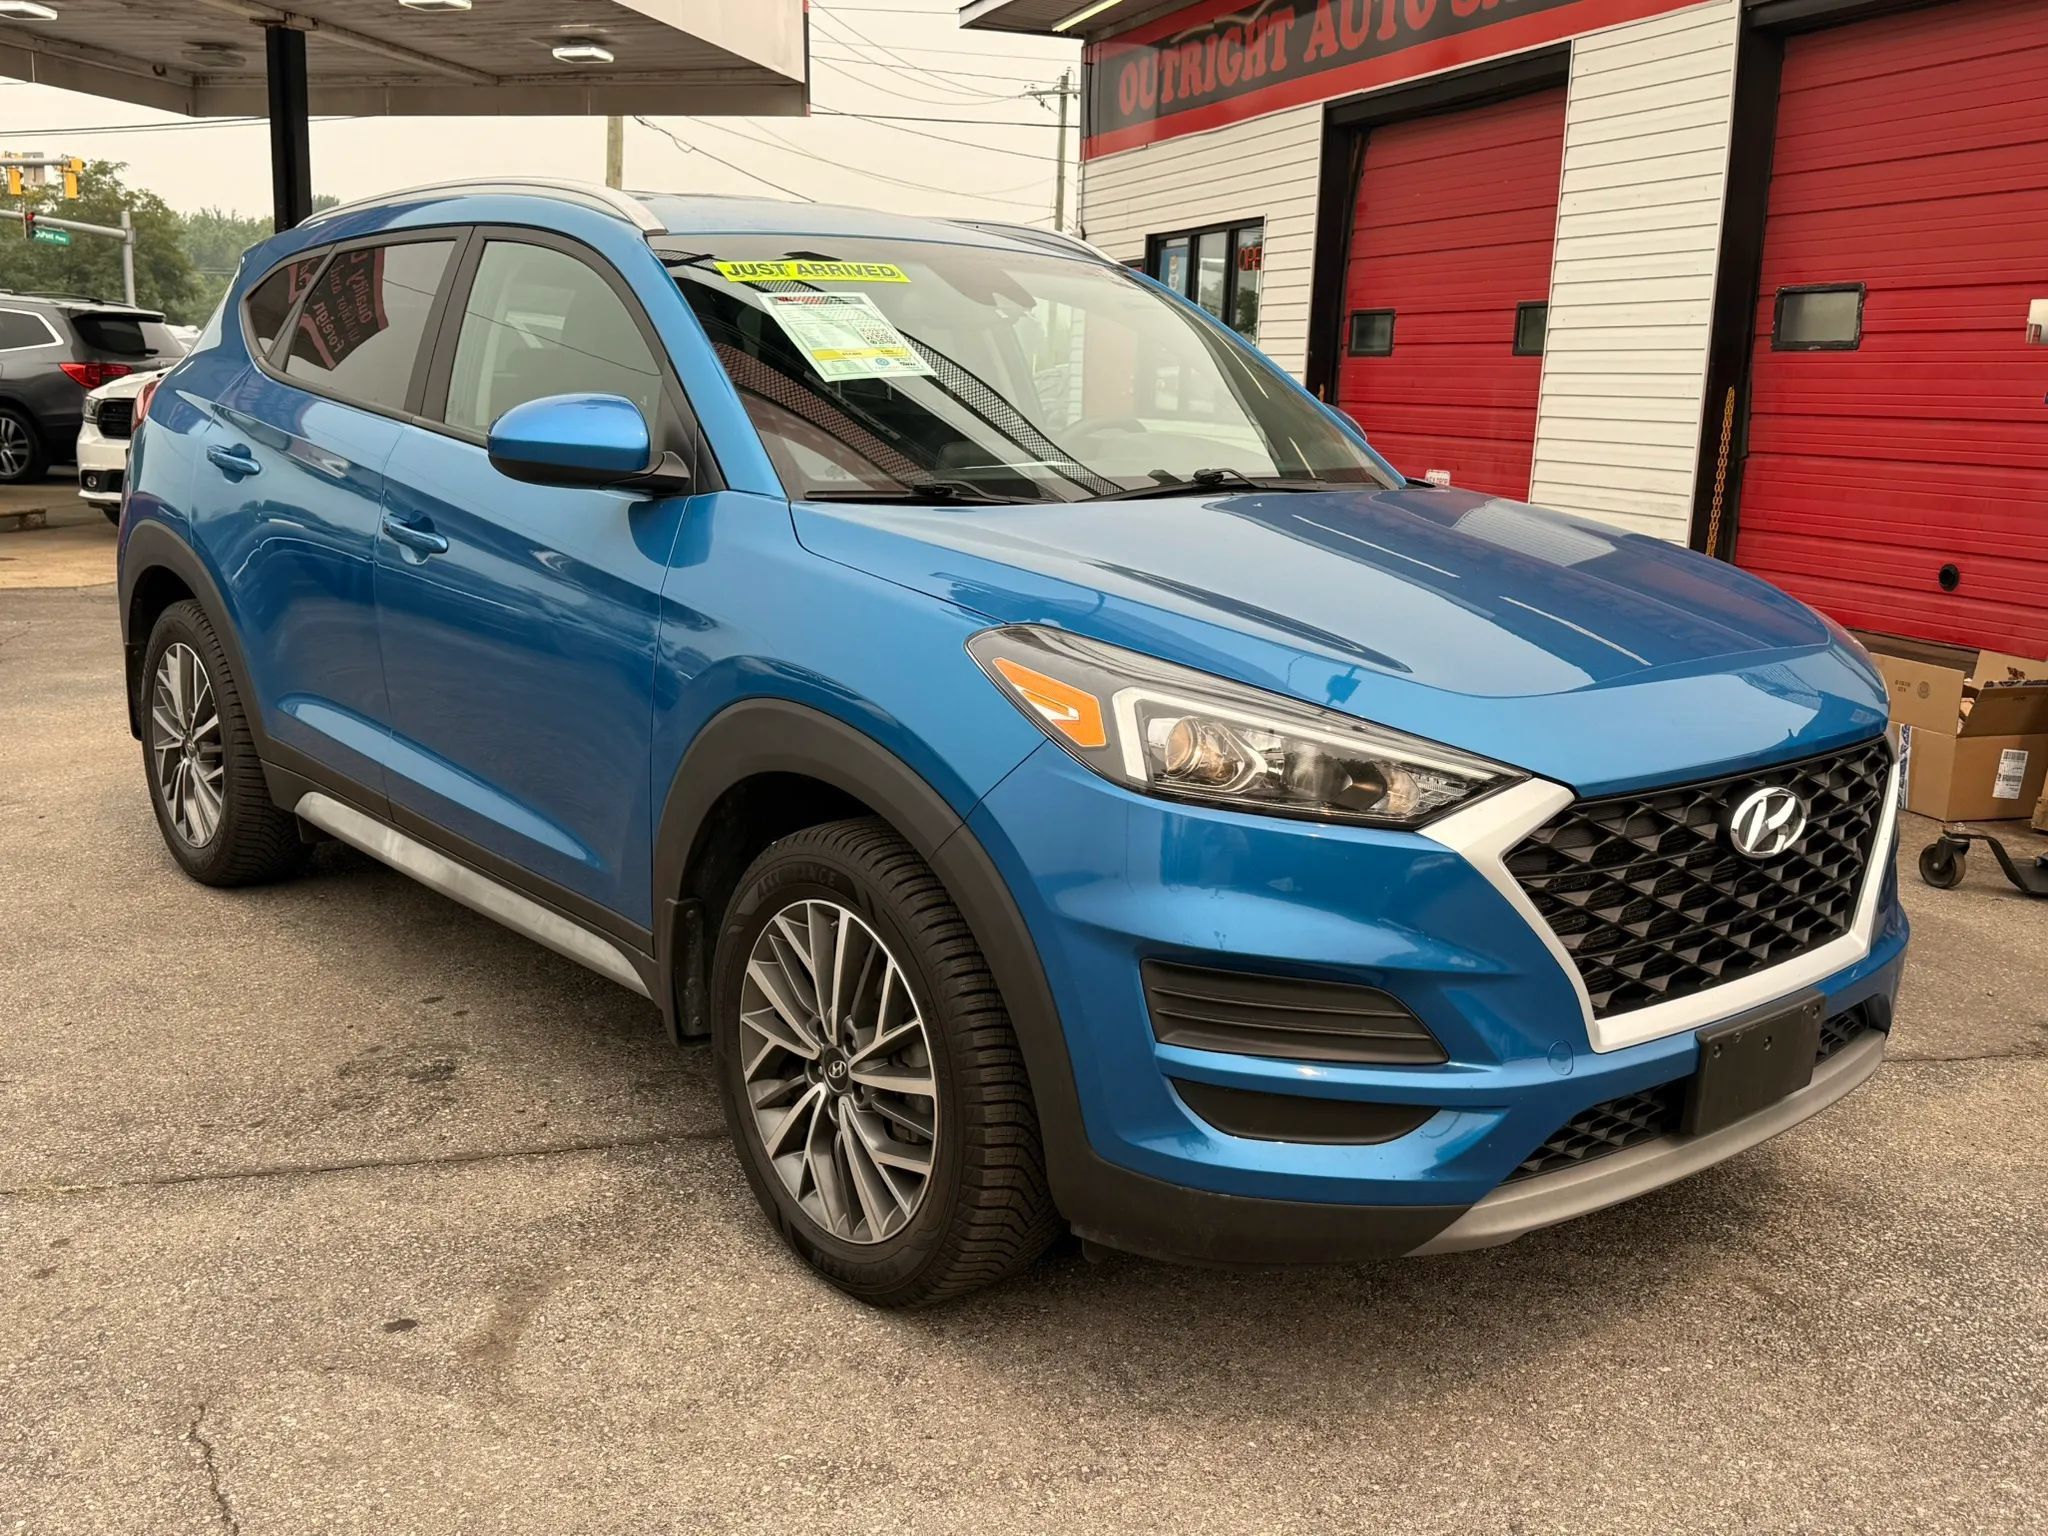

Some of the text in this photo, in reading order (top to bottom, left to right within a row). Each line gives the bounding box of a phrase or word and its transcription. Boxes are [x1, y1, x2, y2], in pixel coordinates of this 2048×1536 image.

[1119, 5, 1296, 116] OUTRIGHT
[727, 263, 897, 278] JUST ARRIVED
[1238, 247, 1263, 272] OPE
